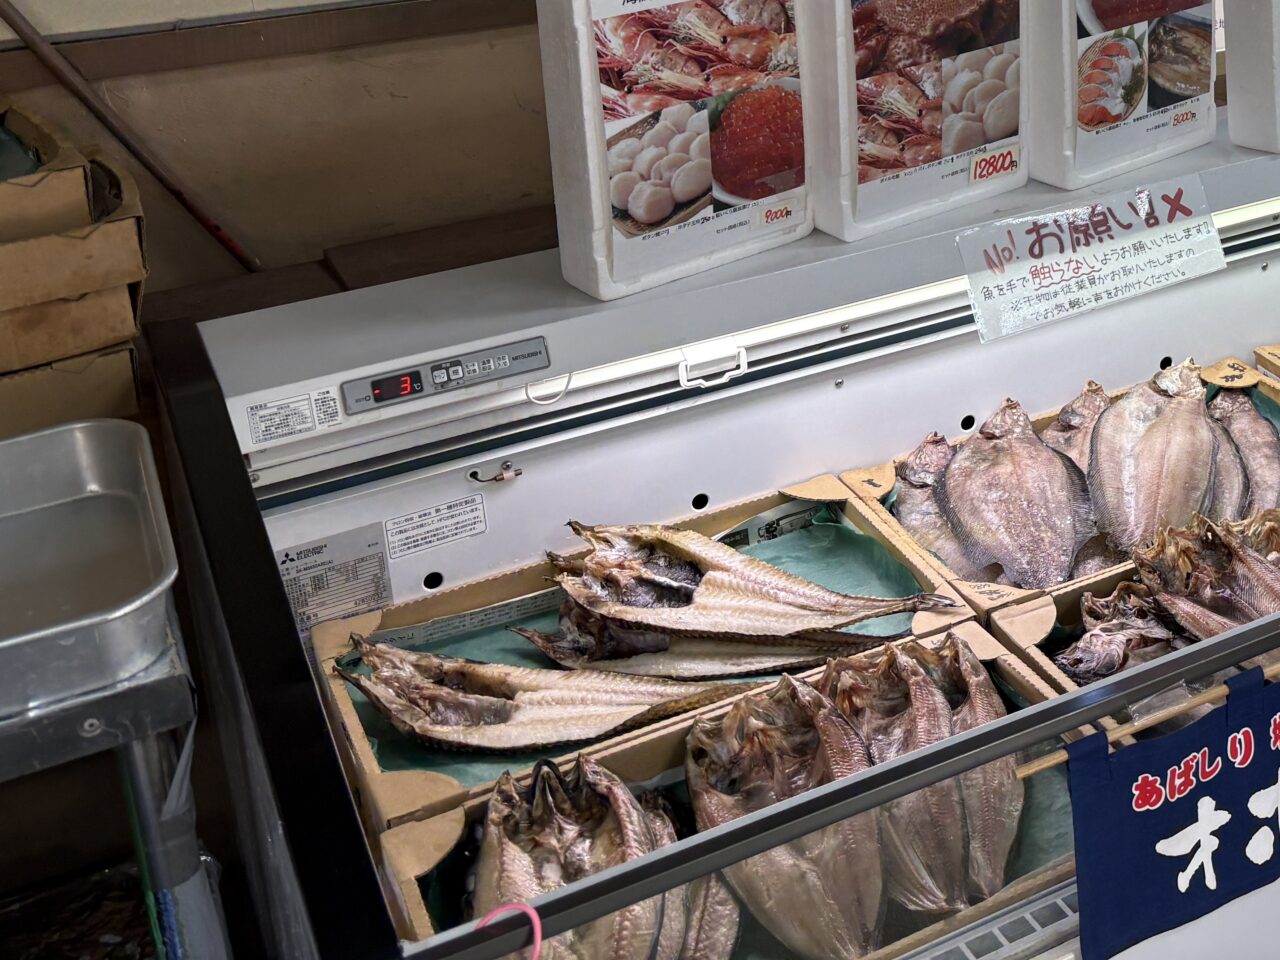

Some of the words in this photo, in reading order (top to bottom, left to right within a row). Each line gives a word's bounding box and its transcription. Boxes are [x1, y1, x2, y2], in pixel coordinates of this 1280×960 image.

[511, 350, 543, 362] MITSUBISHI
[1131, 726, 1255, 812] あばしり
